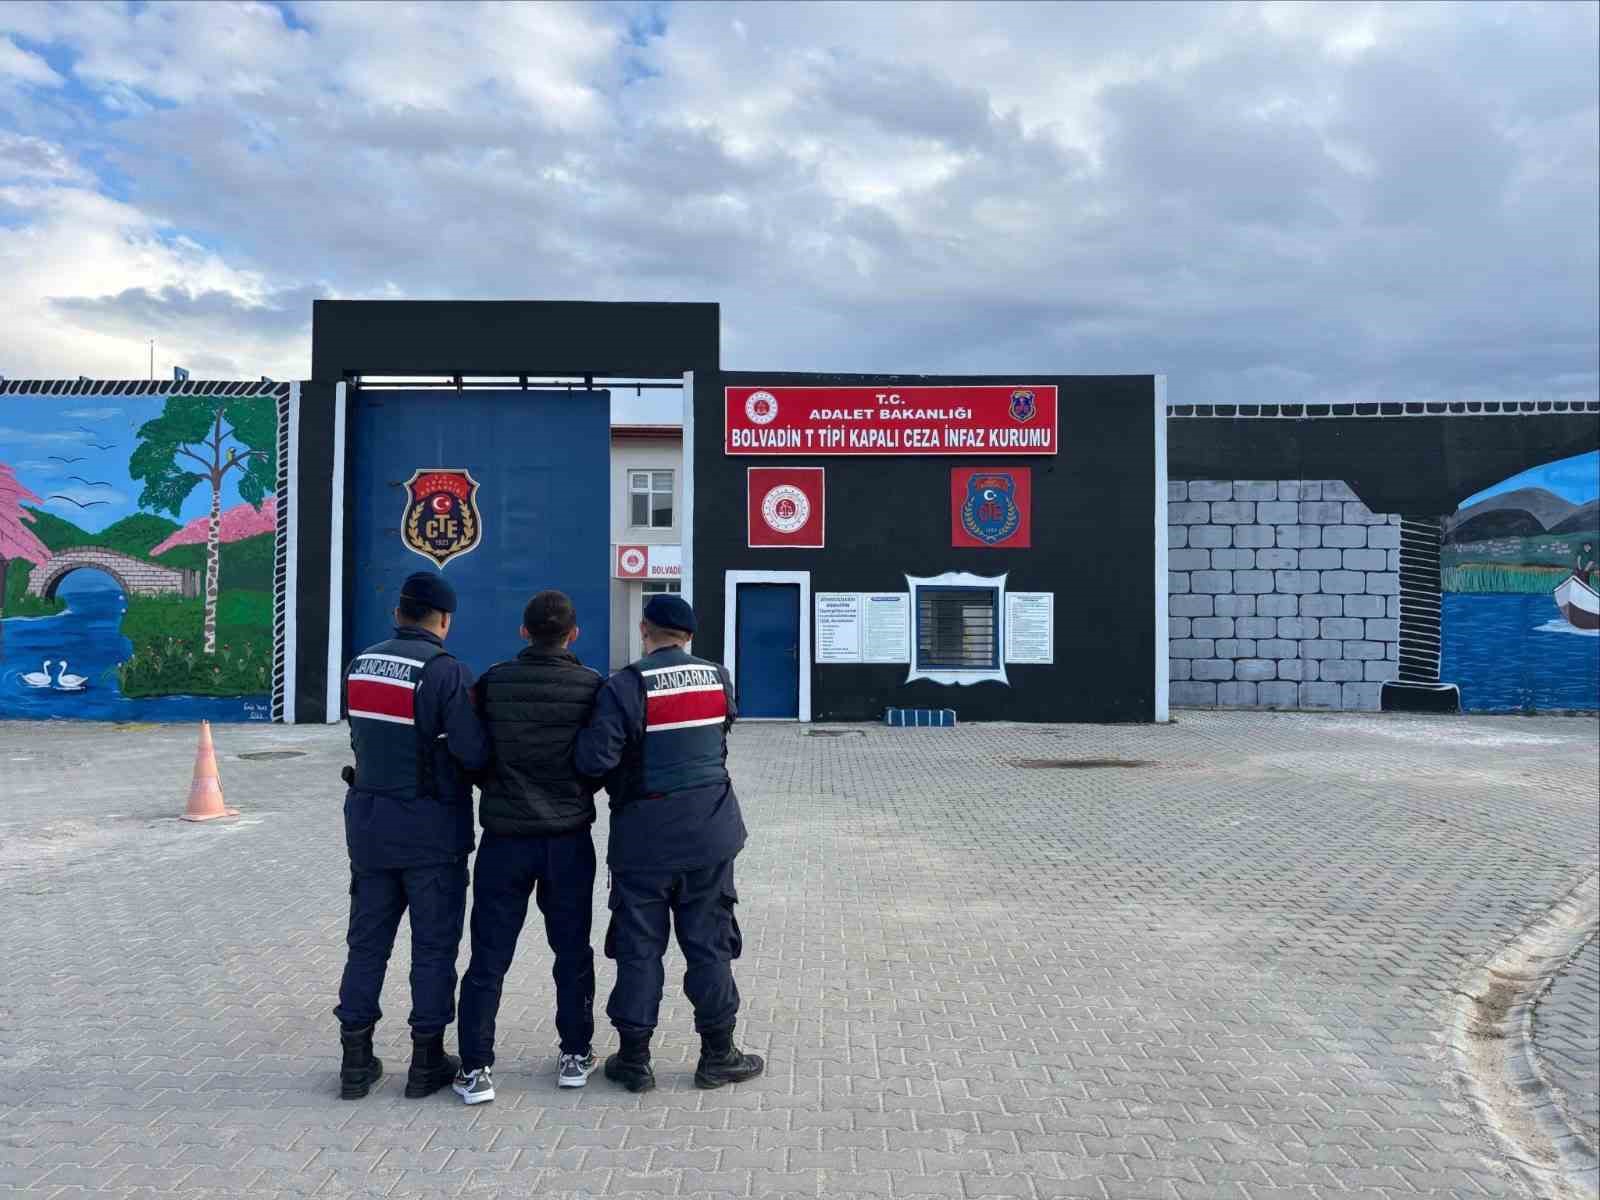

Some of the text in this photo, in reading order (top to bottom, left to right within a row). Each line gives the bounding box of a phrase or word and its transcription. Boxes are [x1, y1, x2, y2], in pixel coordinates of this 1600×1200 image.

[875, 394, 905, 405] T.C.
[809, 407, 972, 420] ADALET BAKANLIĞI
[731, 424, 1051, 448] BOLVADİN T TİPİ KAPALI CEZA İNFAZ KURUMU
[355, 658, 412, 681] JANDARMA
[654, 669, 718, 690] JANDARMA
